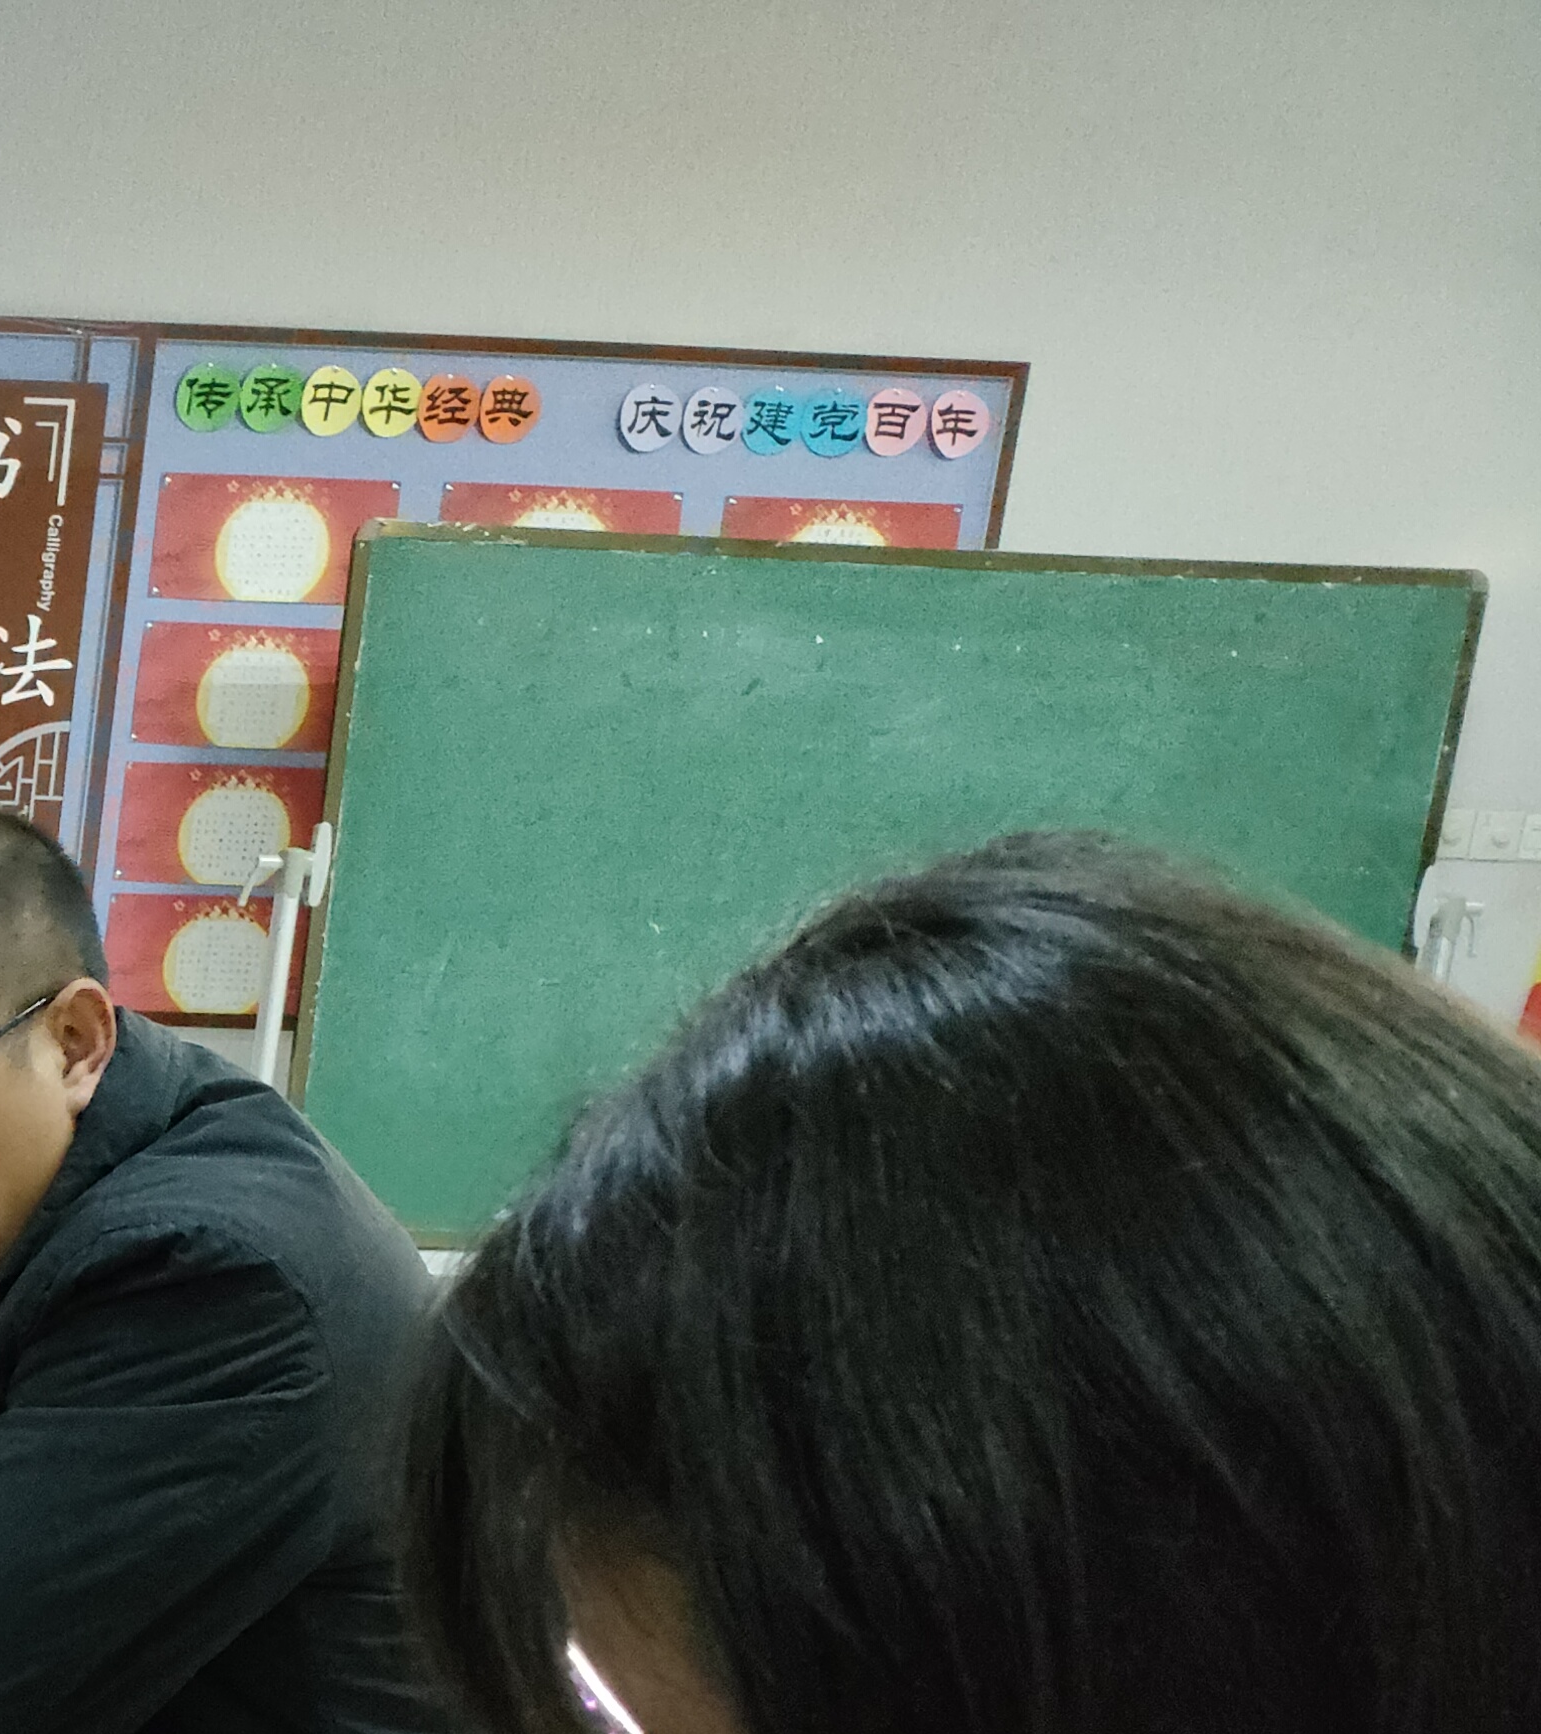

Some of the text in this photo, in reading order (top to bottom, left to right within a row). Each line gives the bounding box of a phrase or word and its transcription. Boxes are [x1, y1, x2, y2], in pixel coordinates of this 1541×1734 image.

[185, 377, 534, 427] 传承中华经典
[627, 396, 978, 446] 庆祝建党百年
[36, 514, 64, 612] Calligraphy
